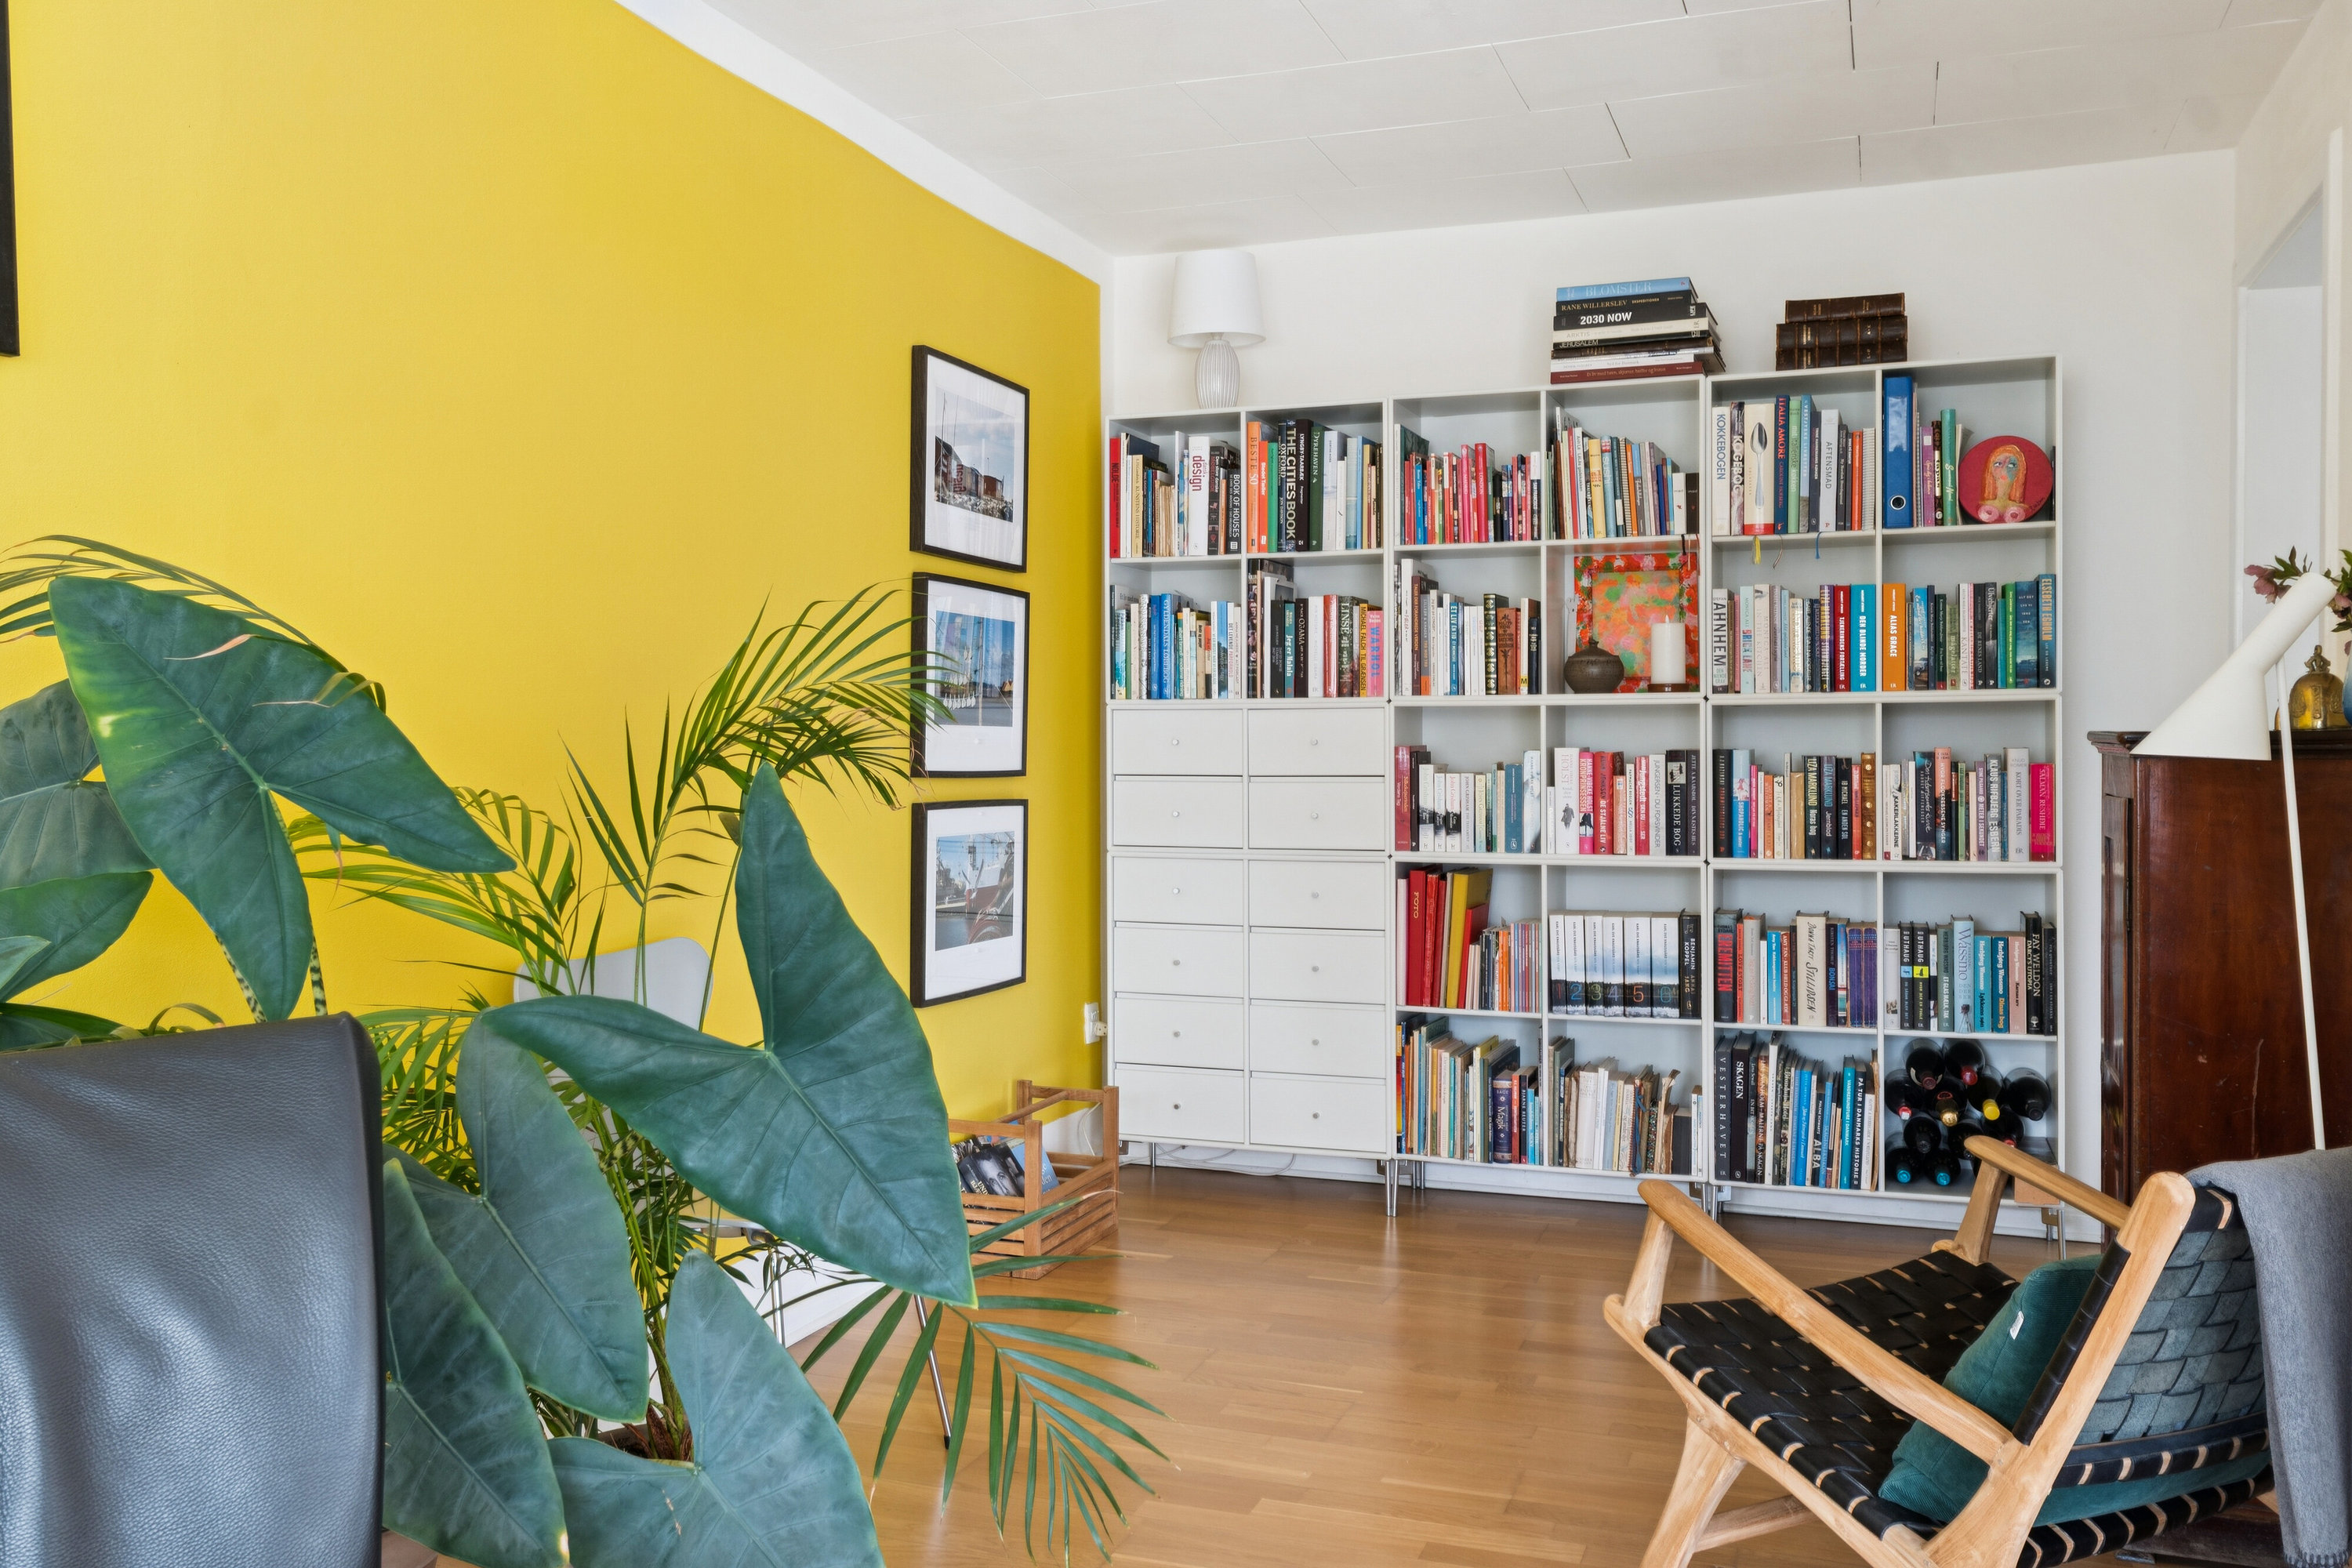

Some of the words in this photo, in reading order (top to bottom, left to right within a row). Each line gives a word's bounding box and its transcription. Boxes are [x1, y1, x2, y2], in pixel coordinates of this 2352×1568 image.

[1561, 302, 1581, 311] RANE
[1582, 299, 1628, 310] WILLERSLEV
[1580, 315, 1604, 325] 2030
[1607, 312, 1632, 323] NOW
[1777, 397, 1787, 426] ITALIA
[1249, 436, 1259, 470] BESTE
[1286, 427, 1297, 455] THE
[1716, 414, 1726, 481] KOKKEBOGEN
[1777, 427, 1787, 459] AMORE
[1312, 432, 1321, 475] DYREHAVEN
[1111, 463, 1120, 483] NOLDE
[1188, 456, 1207, 492] design
[1249, 474, 1259, 485] 50
[1286, 456, 1297, 500] CITIES
[1602, 456, 1613, 485] sushi
[1232, 474, 1240, 495] BOOK
[1232, 497, 1240, 506] OF
[1232, 508, 1240, 539] HOUSES
[1286, 501, 1297, 539] BOOK
[2041, 579, 2053, 612] ELSEBETH
[1162, 600, 1171, 646] GYLDENDALS
[1341, 603, 1350, 634] LINSE
[1889, 615, 1898, 634] ALIAS
[2041, 613, 2053, 641] EGHOLM
[1285, 635, 1294, 646] Jeg
[1712, 602, 1727, 666] AHNHEM
[1741, 630, 1753, 653] BRICK
[1285, 647, 1294, 655] er
[1370, 626, 1381, 677] WARHOL
[1889, 636, 1898, 658] GRACE
[1162, 649, 1171, 684] LØBEBOG
[1285, 656, 1294, 677] Malala
[1741, 655, 1753, 673] LANE
[1560, 754, 1570, 785] HOLST
[1807, 758, 1817, 771] LIZA
[1824, 764, 1833, 775] LIZA
[1988, 759, 1999, 782] KLAUS
[1579, 758, 1588, 812] KRONPRINSESSEN
[1653, 760, 1662, 795] JUNGERSEN
[1807, 772, 1817, 807] MARKLUND
[2038, 768, 2047, 797] SALMAN
[1599, 800, 1608, 808] DE
[1653, 798, 1662, 808] DU
[1824, 776, 1833, 808] MARKLUND
[1840, 786, 1849, 804] MICHAEL
[1988, 783, 1999, 818] RIFBJERG
[1672, 784, 1682, 826] LUKKEDE
[1808, 809, 1817, 825] Noras
[2038, 799, 2047, 830] RUSHDIE
[1599, 809, 1608, 833] STJÅLNE
[1653, 810, 1662, 848] FORSVINDER
[1808, 826, 1817, 836] bog
[1824, 811, 1833, 837] Jernblod
[1840, 816, 1849, 830] ANDEN
[1599, 834, 1608, 844] LIV
[1672, 827, 1682, 847] BOG
[1840, 831, 1849, 840] SOL
[1988, 821, 2001, 853] ESBERN
[1958, 927, 1973, 980] Wassmo
[2032, 934, 2042, 951] FAY
[1717, 933, 1733, 992] EREMITTEN
[1805, 961, 1819, 1013] STILLIDSEN
[1828, 967, 1837, 991] BONSAI
[2032, 953, 2042, 997] WELDON
[1556, 983, 1563, 1000] 1
[1570, 985, 1582, 1001] 2
[1592, 984, 1602, 1001] 3
[1608, 985, 1619, 1002] 4
[1632, 985, 1645, 1003] 5
[1942, 982, 1951, 994] GLAS
[1942, 994, 1951, 1010] MÆLK,
[1942, 1010, 1951, 1018] TAK
[1998, 997, 2006, 1015] Dinas
[1998, 1015, 2006, 1029] bog
[1736, 1061, 1744, 1099] SKAGEN
[1857, 1077, 1865, 1087] PÅ
[1857, 1088, 1865, 1102] TUR
[1496, 1106, 1506, 1131] Magik
[1854, 1108, 1863, 1145] DANMARKS
[1812, 1138, 1823, 1169] ALBA
